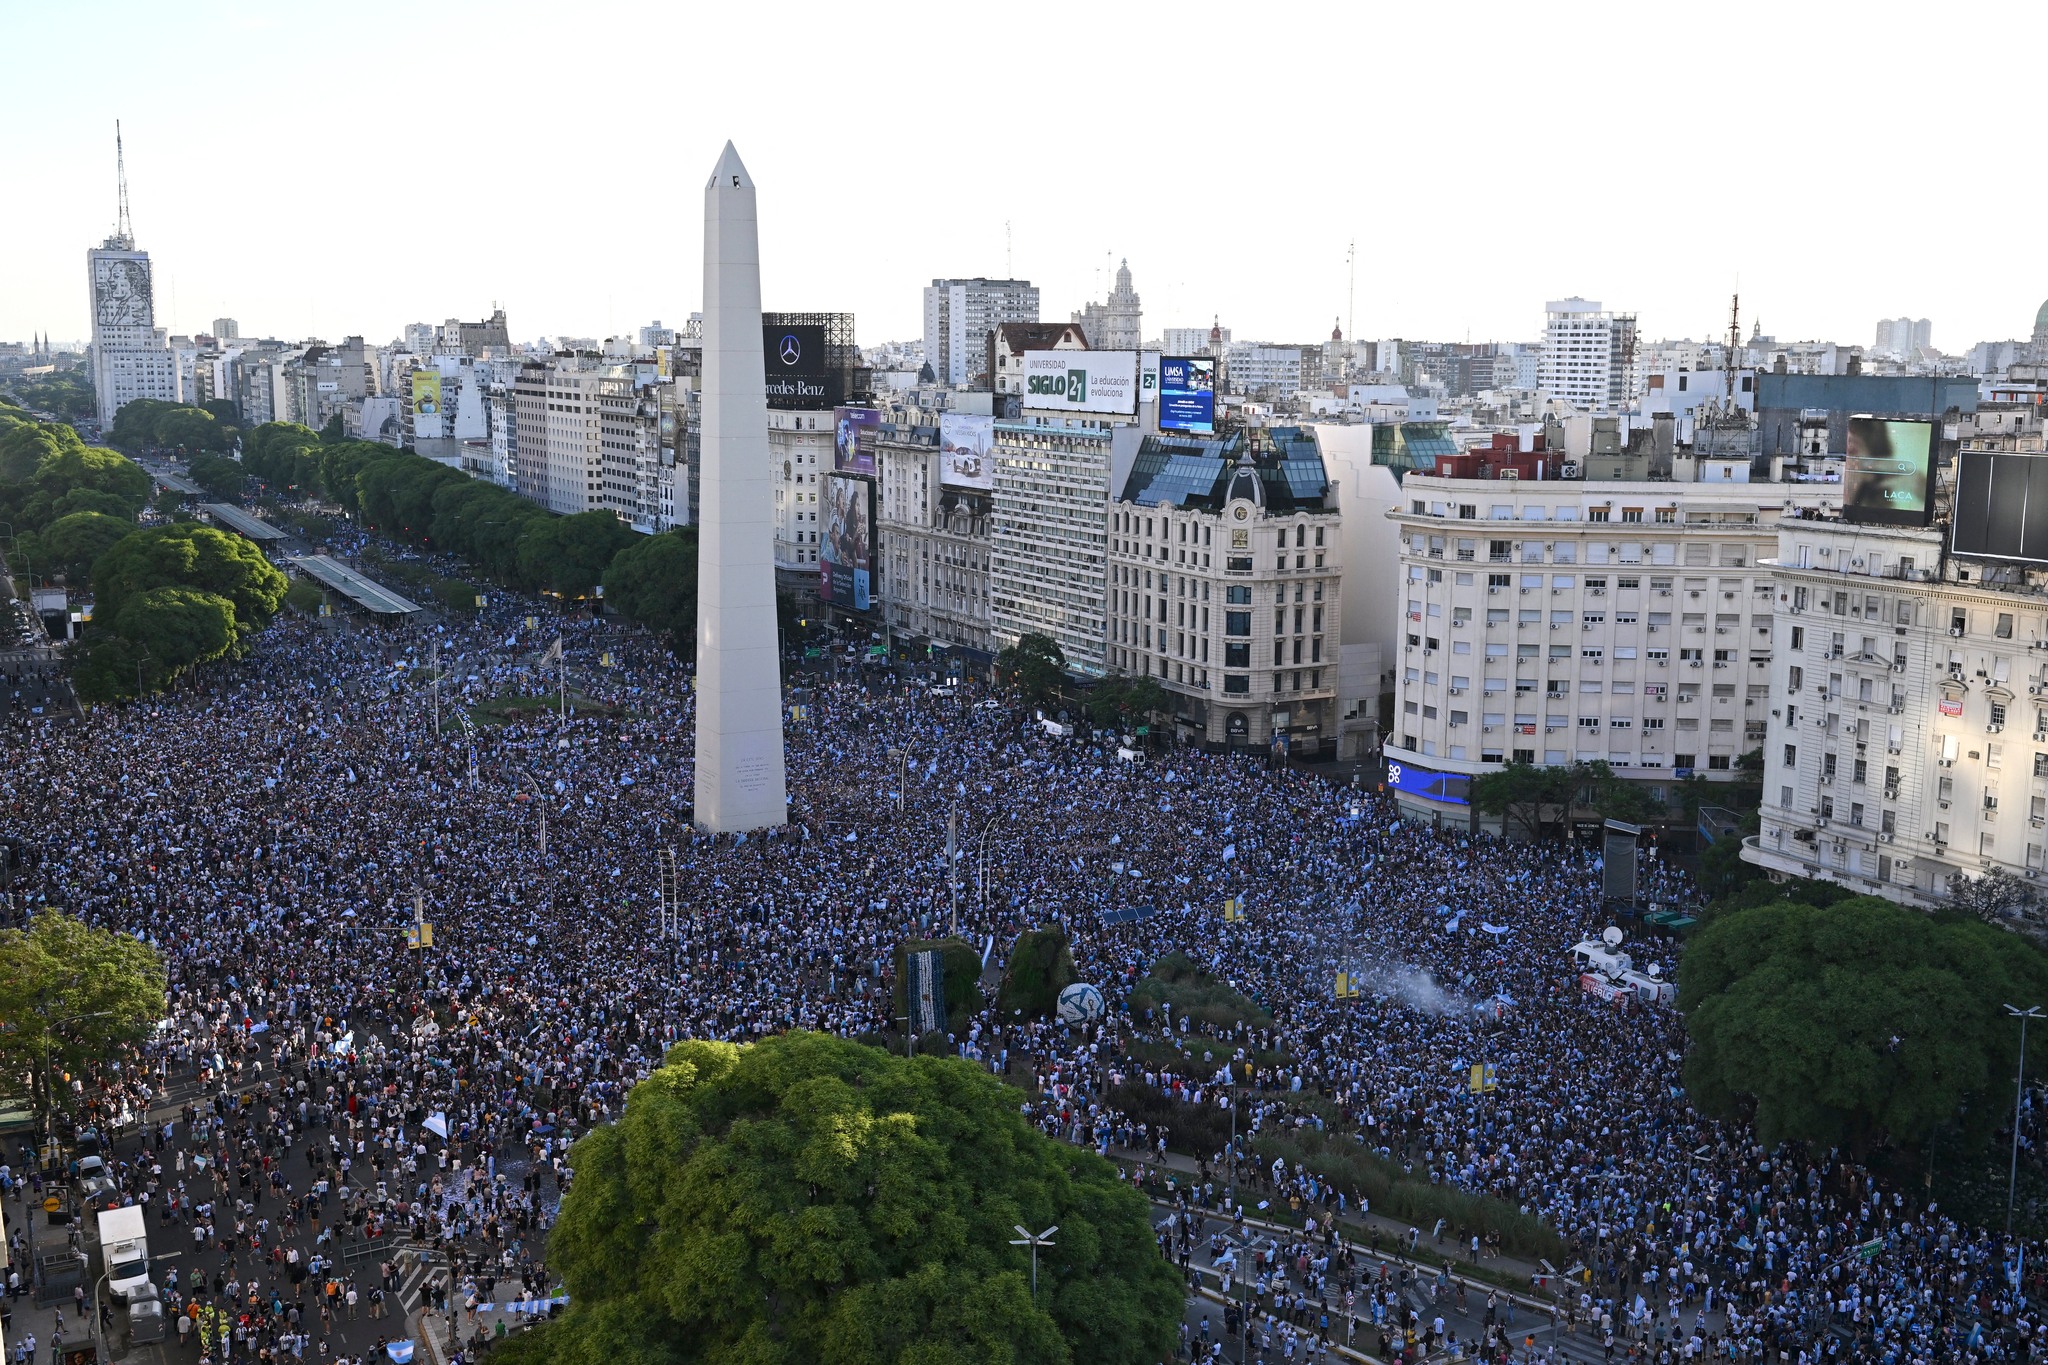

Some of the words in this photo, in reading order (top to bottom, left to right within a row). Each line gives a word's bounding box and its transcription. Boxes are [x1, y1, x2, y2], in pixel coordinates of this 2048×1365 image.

[1029, 360, 1066, 370] UNIVERSIDAD
[1164, 366, 1184, 377] UMSA
[1090, 376, 1098, 385] La
[1099, 376, 1130, 387] educación
[1145, 375, 1156, 389] 21
[765, 380, 825, 396] rcedes-Benz
[1027, 375, 1066, 396] SIGLO
[1069, 375, 1083, 402] 21
[1090, 387, 1124, 398] evoluciona
[1884, 489, 1913, 500] LACA
[1582, 983, 1613, 1001] PUEBLO
